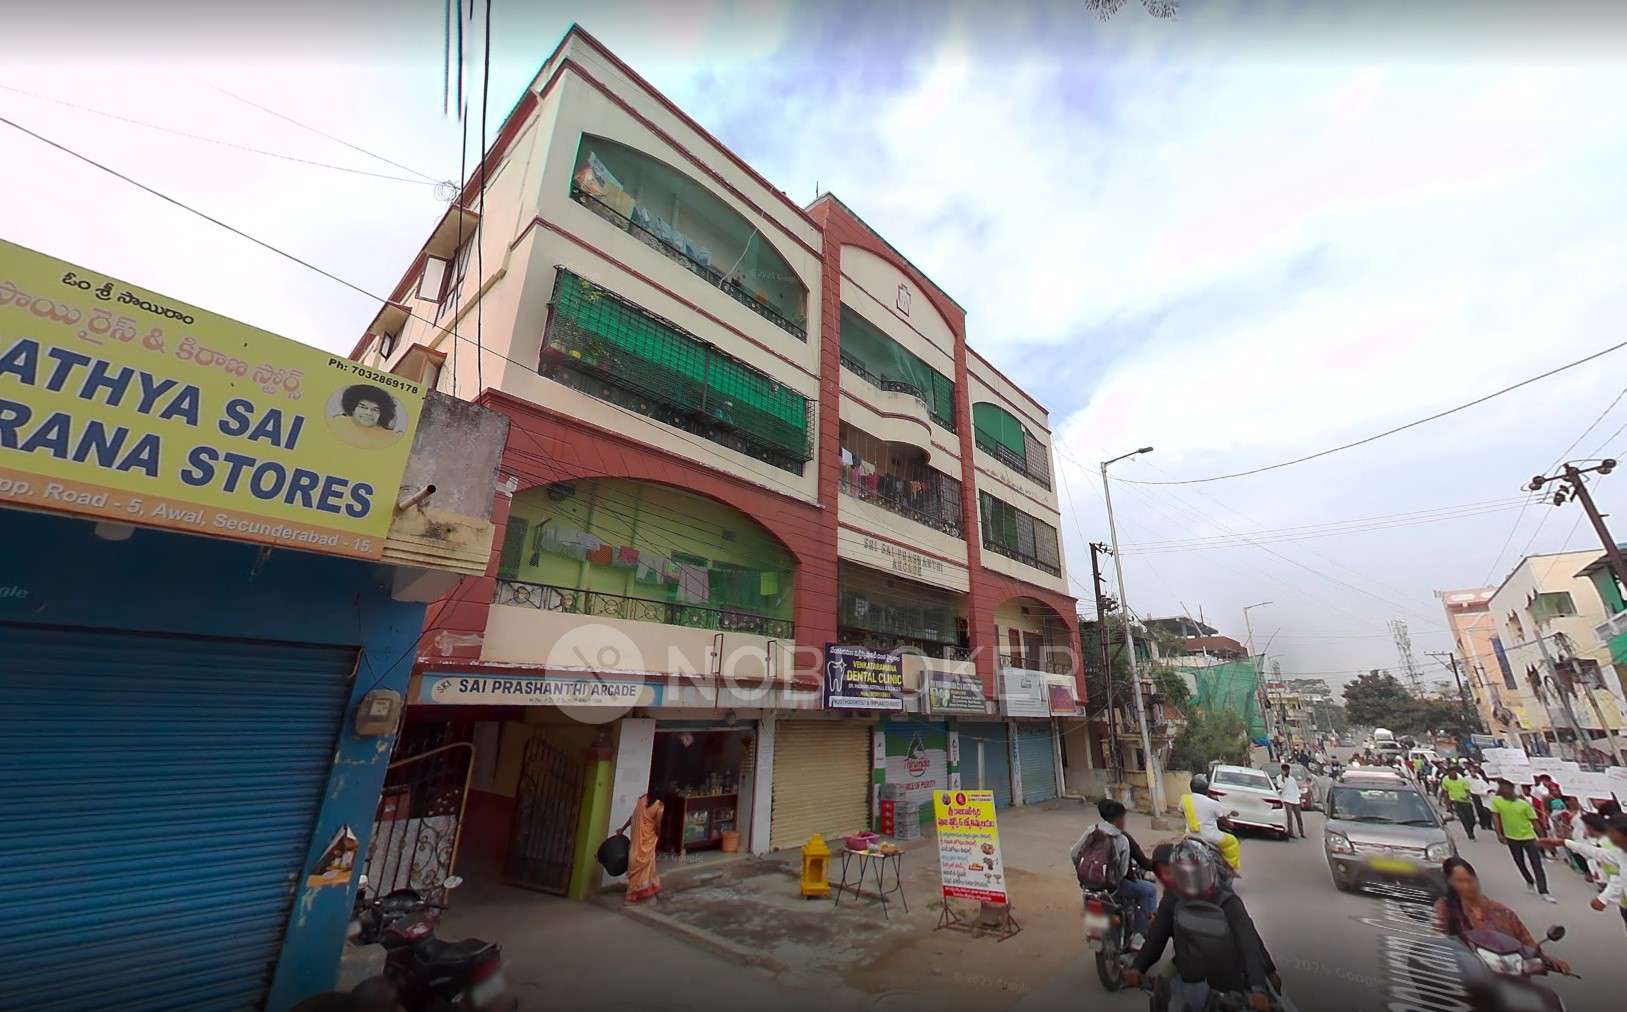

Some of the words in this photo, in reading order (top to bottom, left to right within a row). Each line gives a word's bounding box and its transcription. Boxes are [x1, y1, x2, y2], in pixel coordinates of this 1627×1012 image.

[62, 272, 91, 290] ఓం
[96, 282, 114, 301] శ్రీ
[117, 290, 195, 326] సాయిరాం
[142, 327, 165, 353] &
[0, 338, 200, 427] ATHYA
[218, 398, 305, 451] SAI
[328, 357, 349, 373] Ph:
[351, 366, 419, 395] 7032869178
[0, 401, 162, 478] RANA
[180, 446, 374, 519] STORES
[43, 483, 109, 510] Road
[126, 499, 146, 517] 5,
[151, 503, 207, 526] Awal,
[214, 513, 340, 547] Secunderabad
[459, 679, 486, 694] SAI
[491, 680, 586, 697] PRASHANTHI
[591, 683, 637, 697] ARCADE
[847, 670, 877, 683] DENTAL
[878, 673, 902, 685] CLINIC
